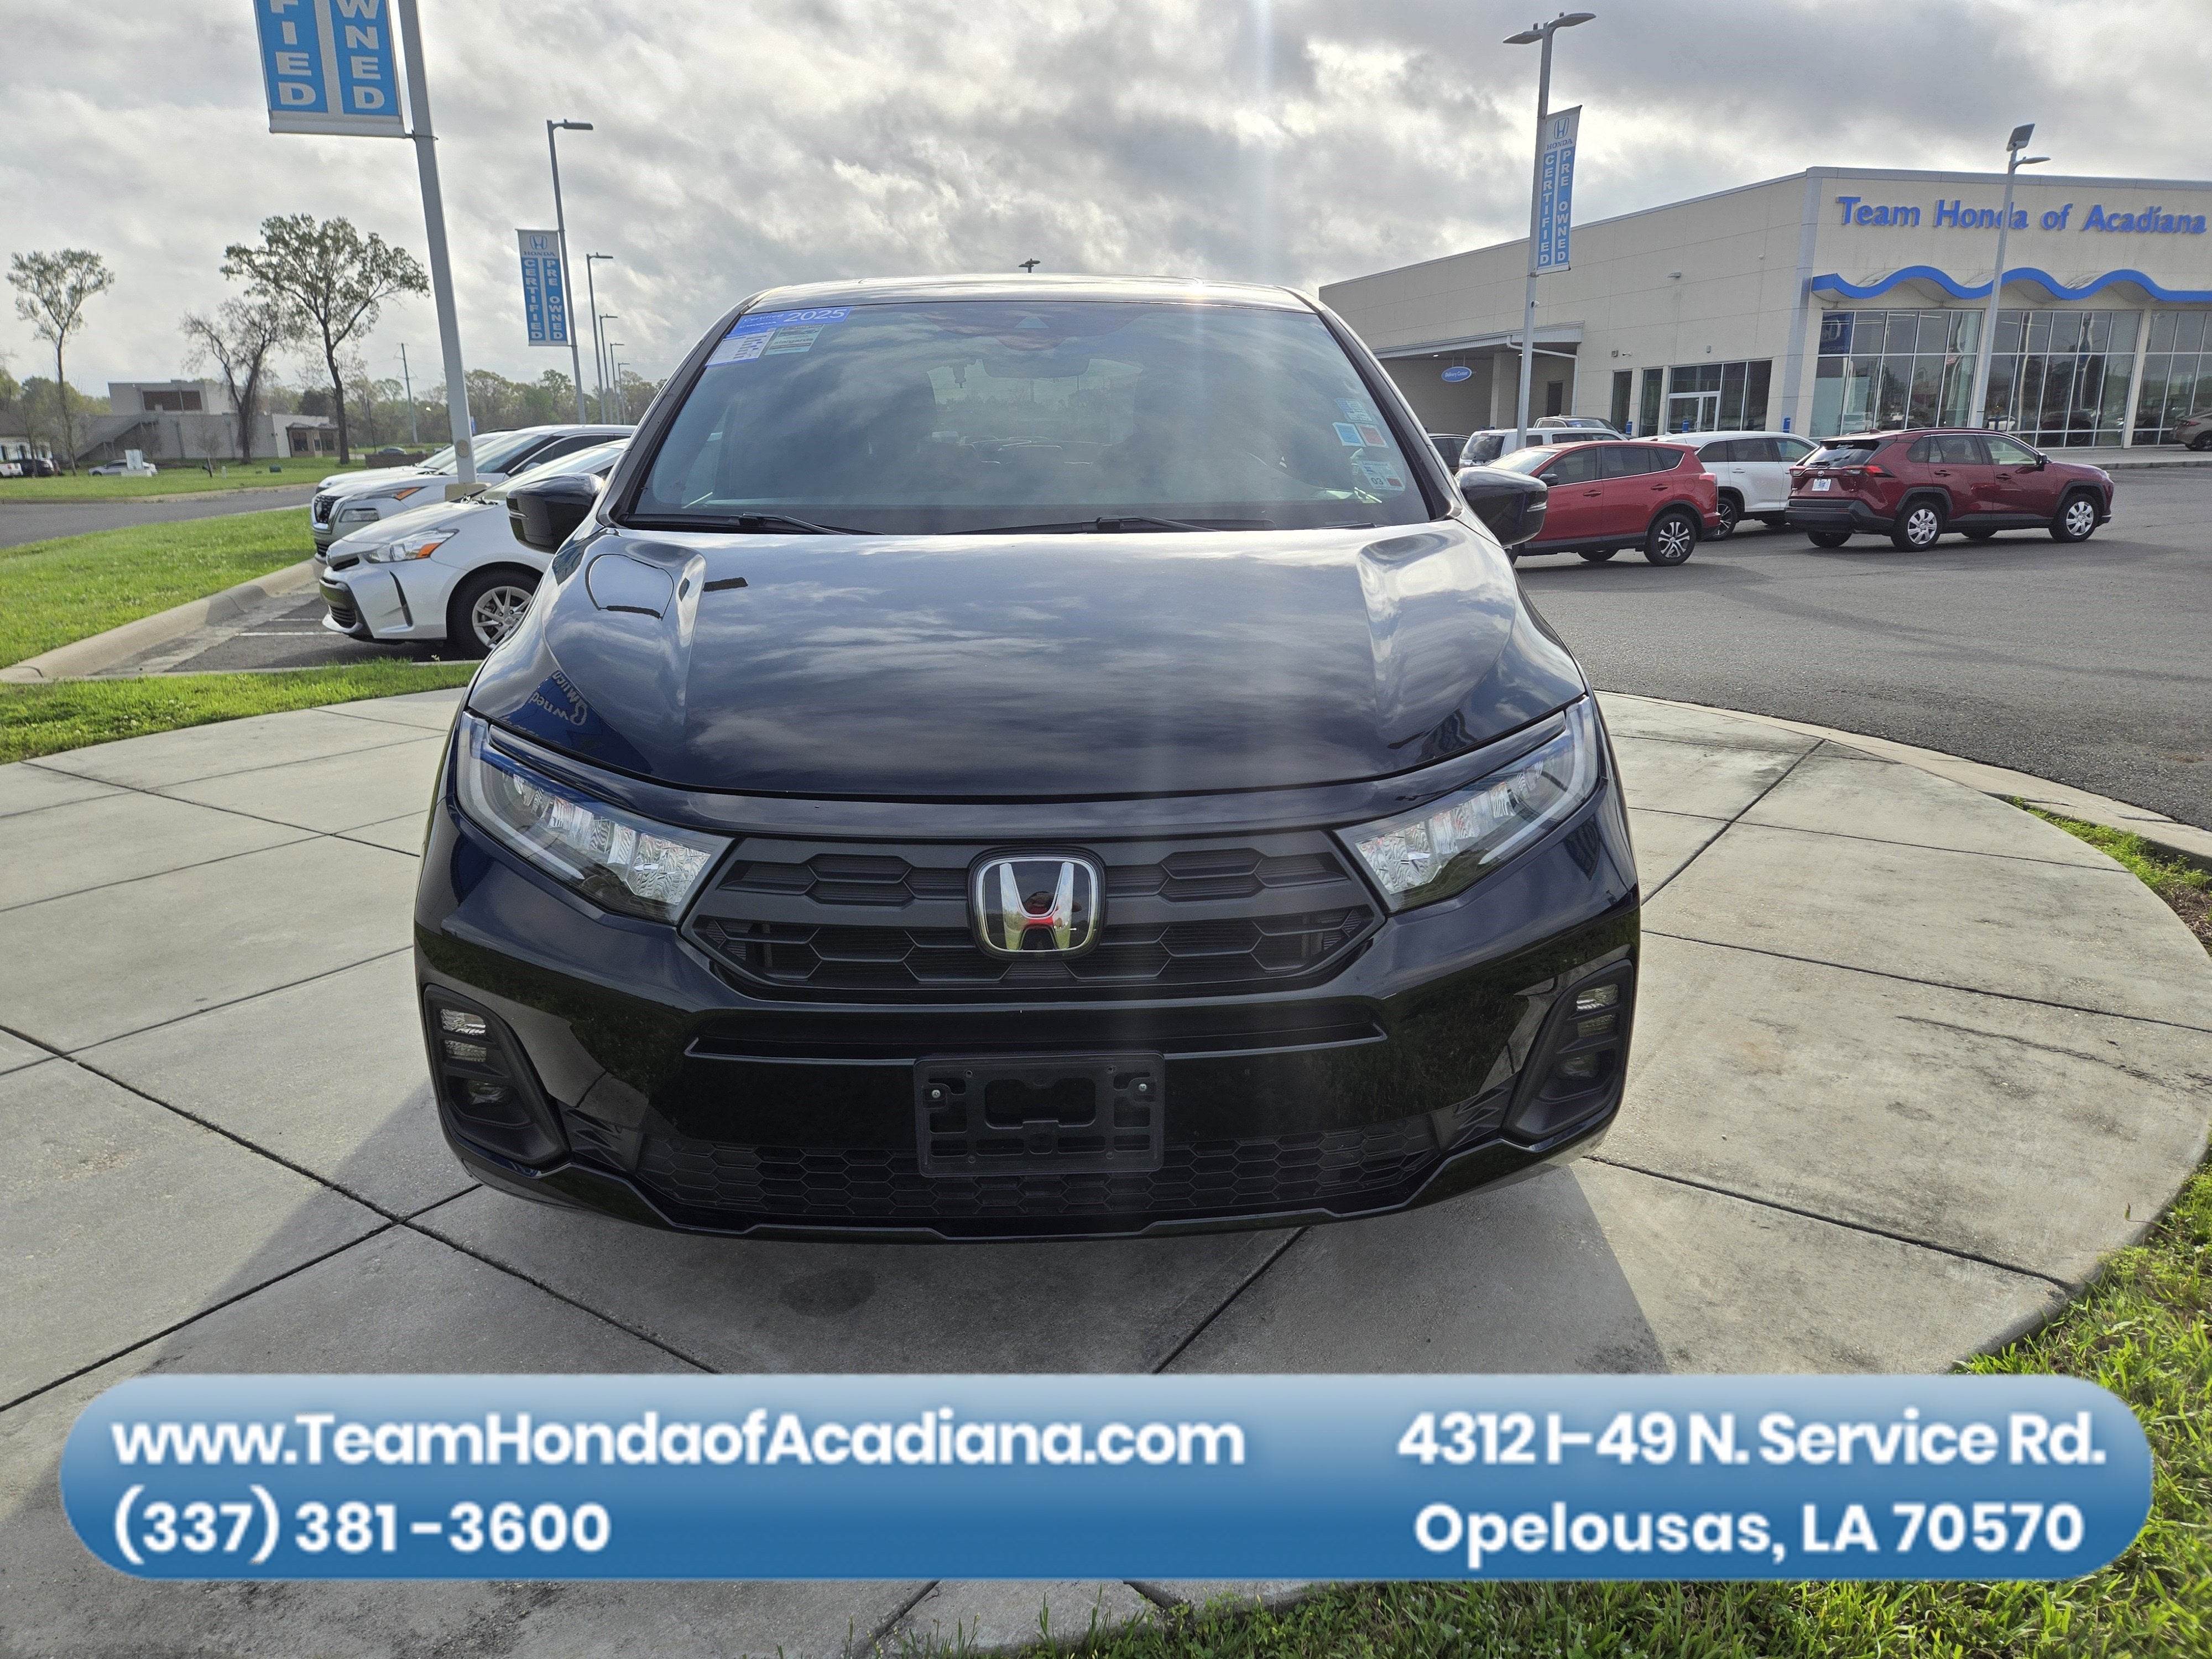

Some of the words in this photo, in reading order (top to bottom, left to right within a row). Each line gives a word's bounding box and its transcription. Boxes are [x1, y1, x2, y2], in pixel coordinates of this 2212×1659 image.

[1546, 138, 1573, 150] HONDA
[1561, 150, 1572, 186] PRE
[1540, 155, 1554, 264] CERTIFIED
[1837, 196, 1921, 226] Team
[1934, 199, 2029, 229] Honda
[2041, 203, 2073, 230] of
[2081, 204, 2207, 233] Acadiana
[1557, 201, 1569, 262] OWNED
[546, 260, 557, 286] PRE
[524, 259, 543, 340] CERTIFIED
[548, 295, 563, 340] OWNED
[783, 309, 847, 322] 2025
